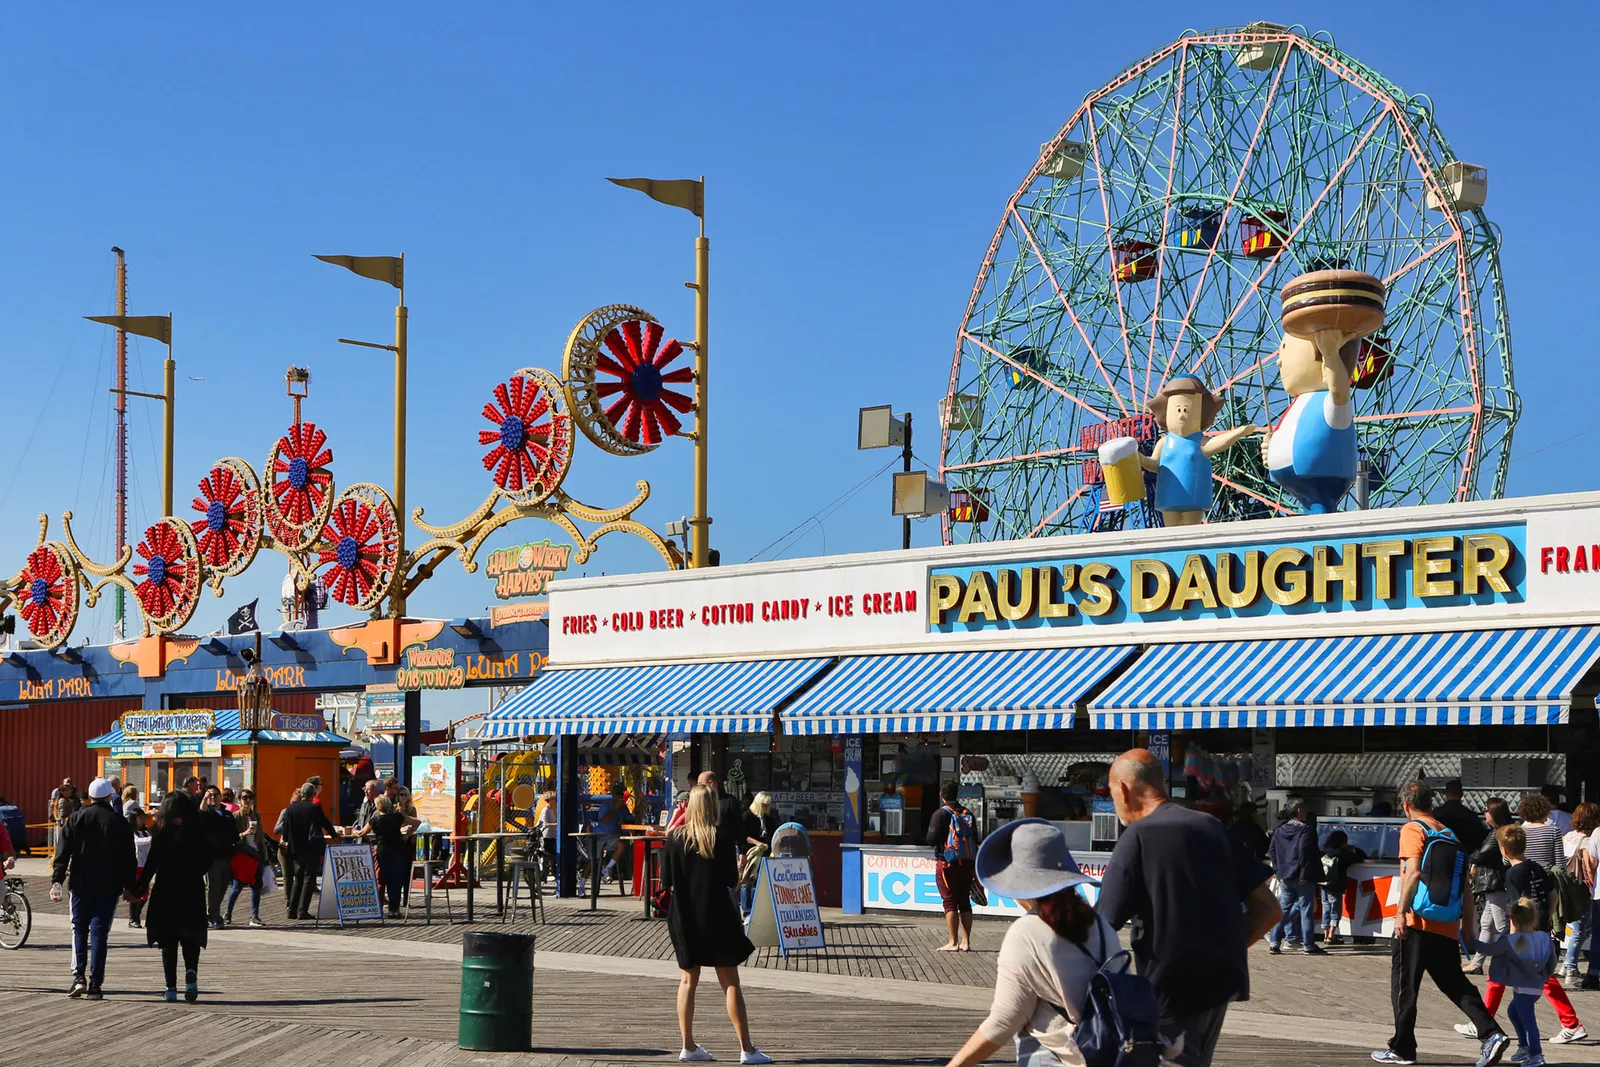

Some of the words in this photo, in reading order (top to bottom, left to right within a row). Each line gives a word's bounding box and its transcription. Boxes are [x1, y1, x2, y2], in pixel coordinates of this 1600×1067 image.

[1081, 414, 1153, 452] WONDER
[496, 570, 554, 596] HARVEST
[929, 561, 1119, 625] PAUL'S
[1130, 532, 1516, 614] DAUGHTER
[562, 614, 598, 635] FRIES
[612, 611, 644, 632] COLD
[649, 608, 684, 630] BEER
[701, 602, 754, 626] COTTON
[761, 598, 809, 622] CANDY
[828, 594, 853, 617] ICE
[862, 590, 917, 615] CREAM
[409, 649, 453, 668] WEEKENDS
[466, 652, 519, 679] LUNA
[264, 665, 306, 689] PARK
[397, 668, 420, 688] 9/16
[423, 669, 434, 686] TO
[435, 667, 464, 688] 10/29
[18, 679, 53, 700] LUNA
[57, 677, 93, 698] PARK
[149, 715, 172, 732] PARK
[280, 716, 318, 730] Tickets
[845, 738, 861, 748] ICE
[1149, 734, 1168, 745] ICE
[844, 748, 862, 762] CREAM
[796, 793, 815, 801] BEER
[333, 856, 364, 880] BEER
[867, 855, 909, 869] COTTON
[351, 867, 375, 881] BAR
[773, 868, 784, 882] Ice
[785, 868, 807, 882] Cream
[340, 884, 374, 897] PAUL'S
[773, 883, 800, 905] FUNNEL
[799, 883, 814, 904] CAKE
[867, 871, 943, 904] ICE
[341, 896, 376, 907] DAUGHTER
[780, 909, 803, 923] ITALIAN
[782, 923, 818, 939] Slushies
